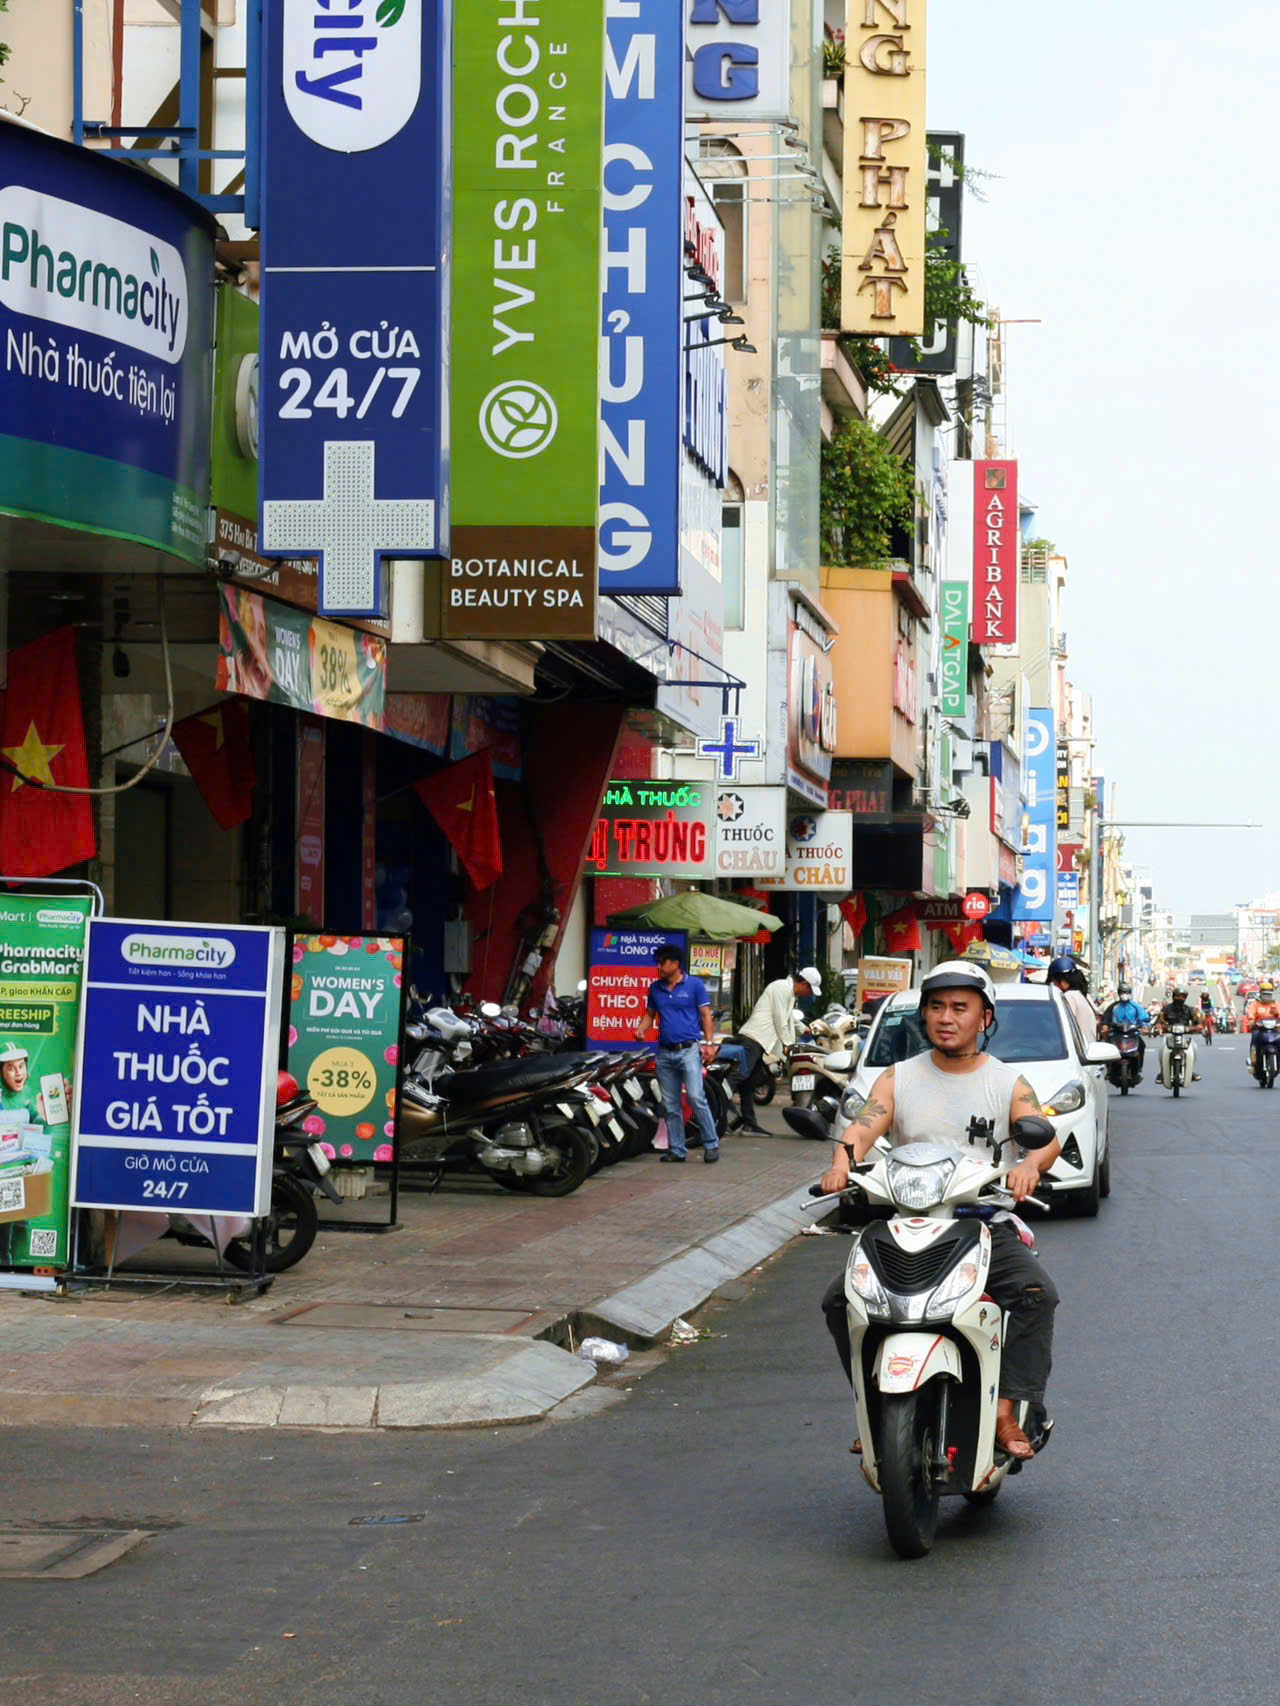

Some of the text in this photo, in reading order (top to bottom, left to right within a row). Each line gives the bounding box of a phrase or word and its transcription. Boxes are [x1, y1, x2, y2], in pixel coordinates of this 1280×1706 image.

[295, 0, 378, 111] ity
[603, 0, 656, 99] M
[547, 42, 567, 213] FRANCE
[859, 116, 910, 320] PHÁT
[2, 222, 180, 352] Pharmacity
[492, 198, 537, 356] YVES
[280, 319, 420, 360] MỞ CỬA
[599, 143, 653, 572] CHỦNG
[7, 329, 175, 421] Nhà thuốc tiện lợi
[278, 367, 421, 420] 24/7
[451, 559, 583, 578] BOTANICAL
[985, 494, 1004, 637] AGRIBANK
[450, 589, 583, 608] BEAUTY SPA
[275, 647, 300, 692] DAY
[637, 785, 701, 808] THUỐC
[613, 810, 706, 863] TRƯNG
[722, 824, 774, 841] THUỐC
[719, 847, 777, 870] CHÂU
[797, 842, 843, 859] THUỐC
[793, 864, 846, 885] CHÂU
[924, 903, 959, 916] ATM
[965, 898, 985, 910] ria
[620, 935, 666, 944] NHÀ THUỐC
[620, 946, 649, 955] LONG
[129, 941, 226, 965] Pharmacity
[1, 960, 80, 974] GrabMart
[311, 976, 385, 990] WOMEN'S
[591, 974, 638, 988] CHUYÊN
[309, 989, 384, 1019] DAY
[598, 994, 639, 1008] THEO
[137, 1000, 210, 1036] NHÀ
[593, 1015, 622, 1030] BỆNH
[113, 1043, 230, 1086] THUỐC
[312, 1069, 372, 1089] -38%
[105, 1097, 233, 1136] GIÁ TỐT
[125, 1154, 209, 1174] GIỜ MỞ CỬA
[142, 1180, 189, 1200] 24/7
